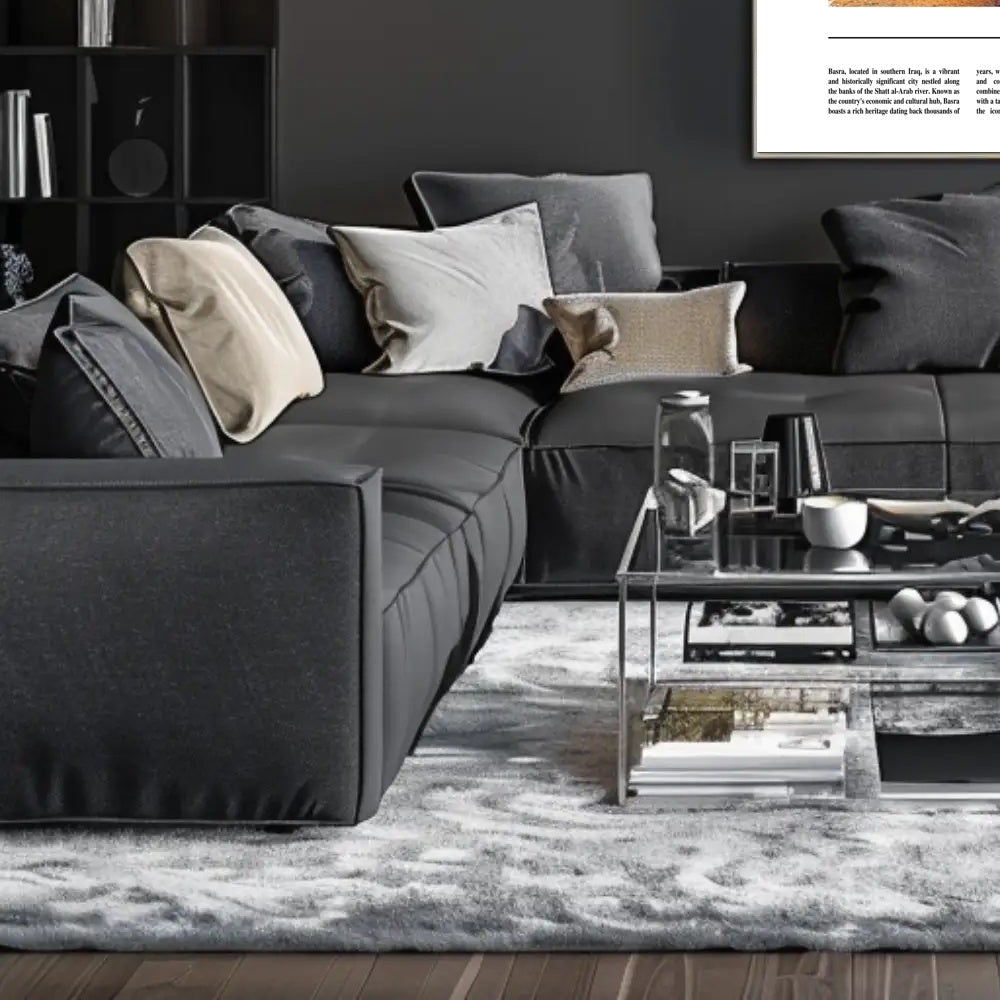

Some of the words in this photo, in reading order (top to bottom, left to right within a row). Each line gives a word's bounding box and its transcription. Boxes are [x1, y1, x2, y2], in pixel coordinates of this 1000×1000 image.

[828, 67, 846, 76] Basra,
[849, 67, 869, 75] located
[872, 67, 878, 75] in
[880, 67, 905, 75] southern
[908, 67, 922, 77] Iraq,
[925, 67, 930, 75] is
[939, 67, 960, 75] vibrant
[976, 69, 993, 77] years,
[828, 77, 839, 85] and
[842, 77, 873, 86] historically
[876, 77, 905, 86] significant
[908, 77, 918, 86] city
[921, 77, 941, 85] nestled
[944, 77, 960, 86] along
[976, 77, 987, 85] and
[828, 87, 837, 95] the
[839, 87, 856, 95] banks
[857, 87, 863, 95] of
[864, 87, 873, 95] the
[875, 87, 890, 95] Shatt
[891, 87, 913, 95] al-Arab
[914, 87, 930, 95] river.
[932, 87, 952, 95] Known
[828, 97, 837, 105] the
[838, 97, 865, 106] country's
[866, 97, 892, 105] economic
[893, 97, 904, 105] and
[905, 97, 928, 105] cultural
[929, 97, 942, 106] hub,
[943, 97, 960, 105] Basra
[976, 97, 989, 105] with
[828, 107, 846, 115] boasts
[852, 107, 864, 115] rich
[865, 107, 888, 116] heritage
[889, 107, 908, 116] dating
[909, 107, 922, 115] back
[924, 107, 953, 115] thousands
[954, 107, 960, 115] of
[976, 107, 985, 115] the
